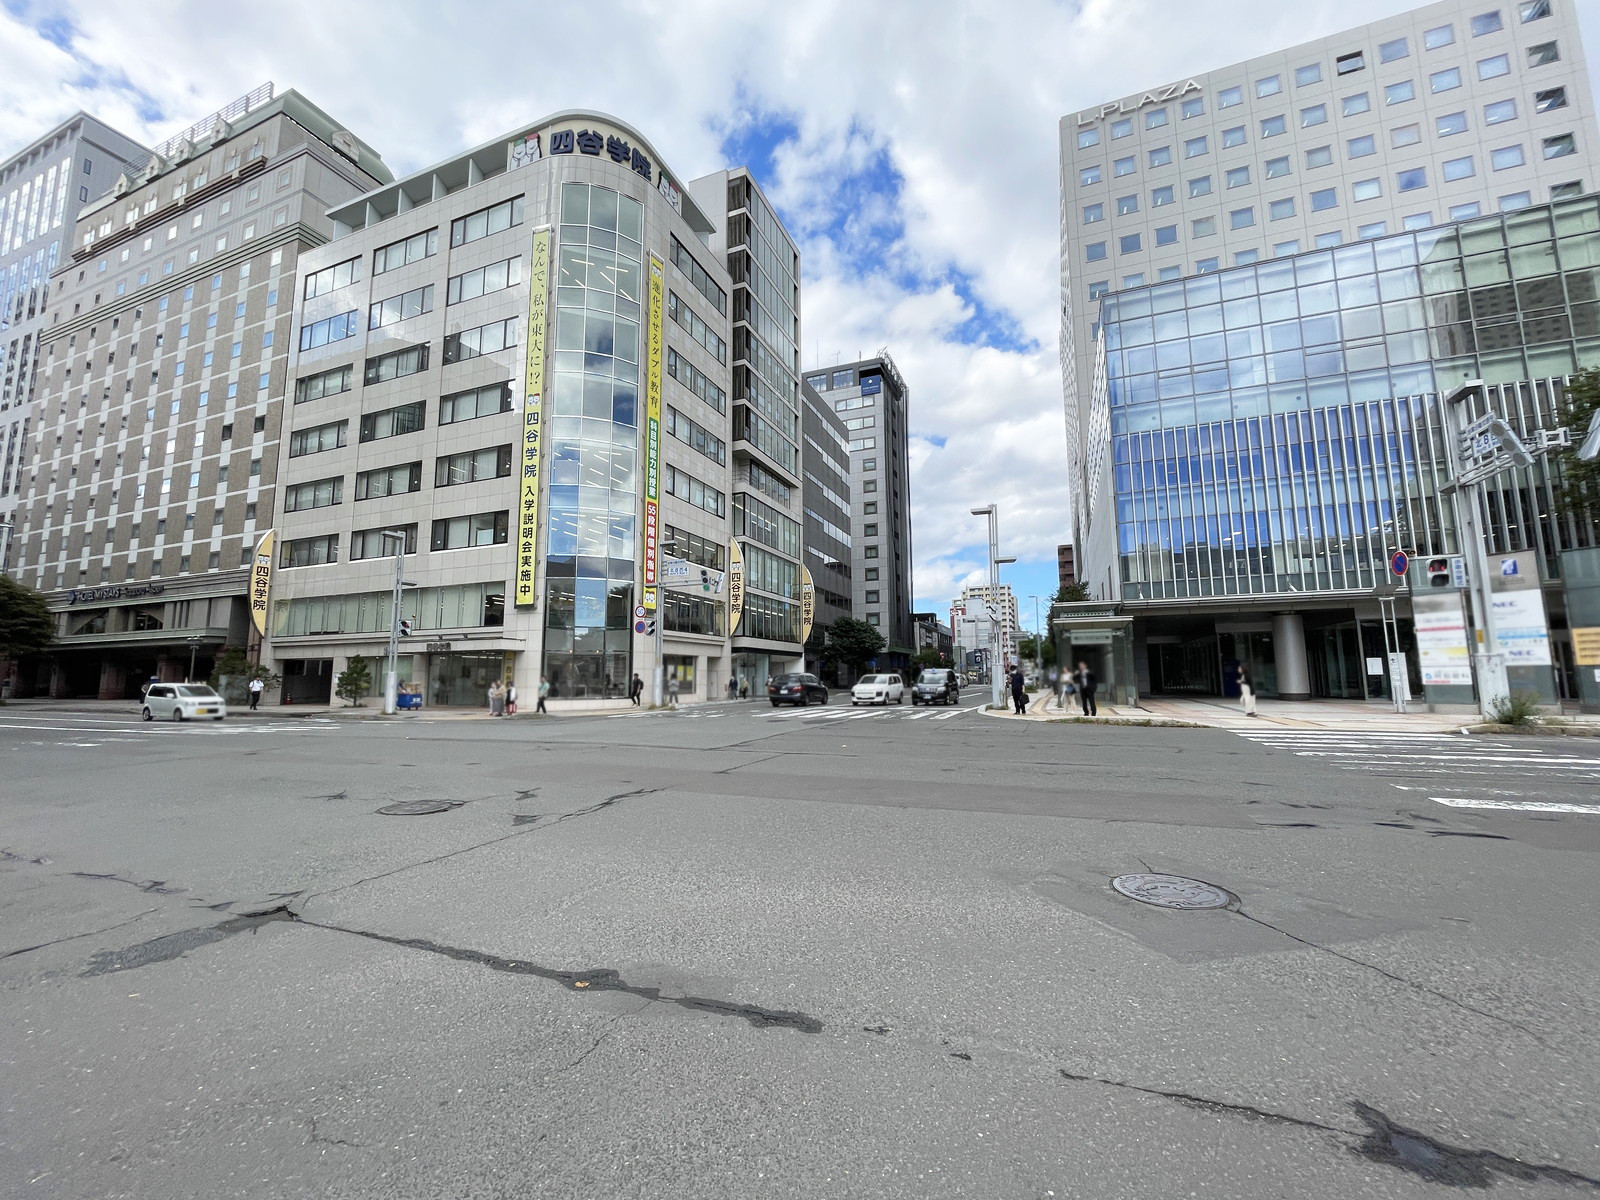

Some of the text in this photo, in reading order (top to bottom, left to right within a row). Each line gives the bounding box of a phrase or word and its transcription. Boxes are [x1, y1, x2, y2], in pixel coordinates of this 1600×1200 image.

[550, 128, 652, 182] 四谷学院
[519, 411, 540, 596] 四谷学院 入学説明会実施中
[253, 565, 270, 611] 四谷学院
[731, 572, 742, 614] 四谷学院
[803, 591, 812, 626] 四谷学院
[1492, 600, 1518, 608] NEC
[1509, 649, 1536, 657] NEC
